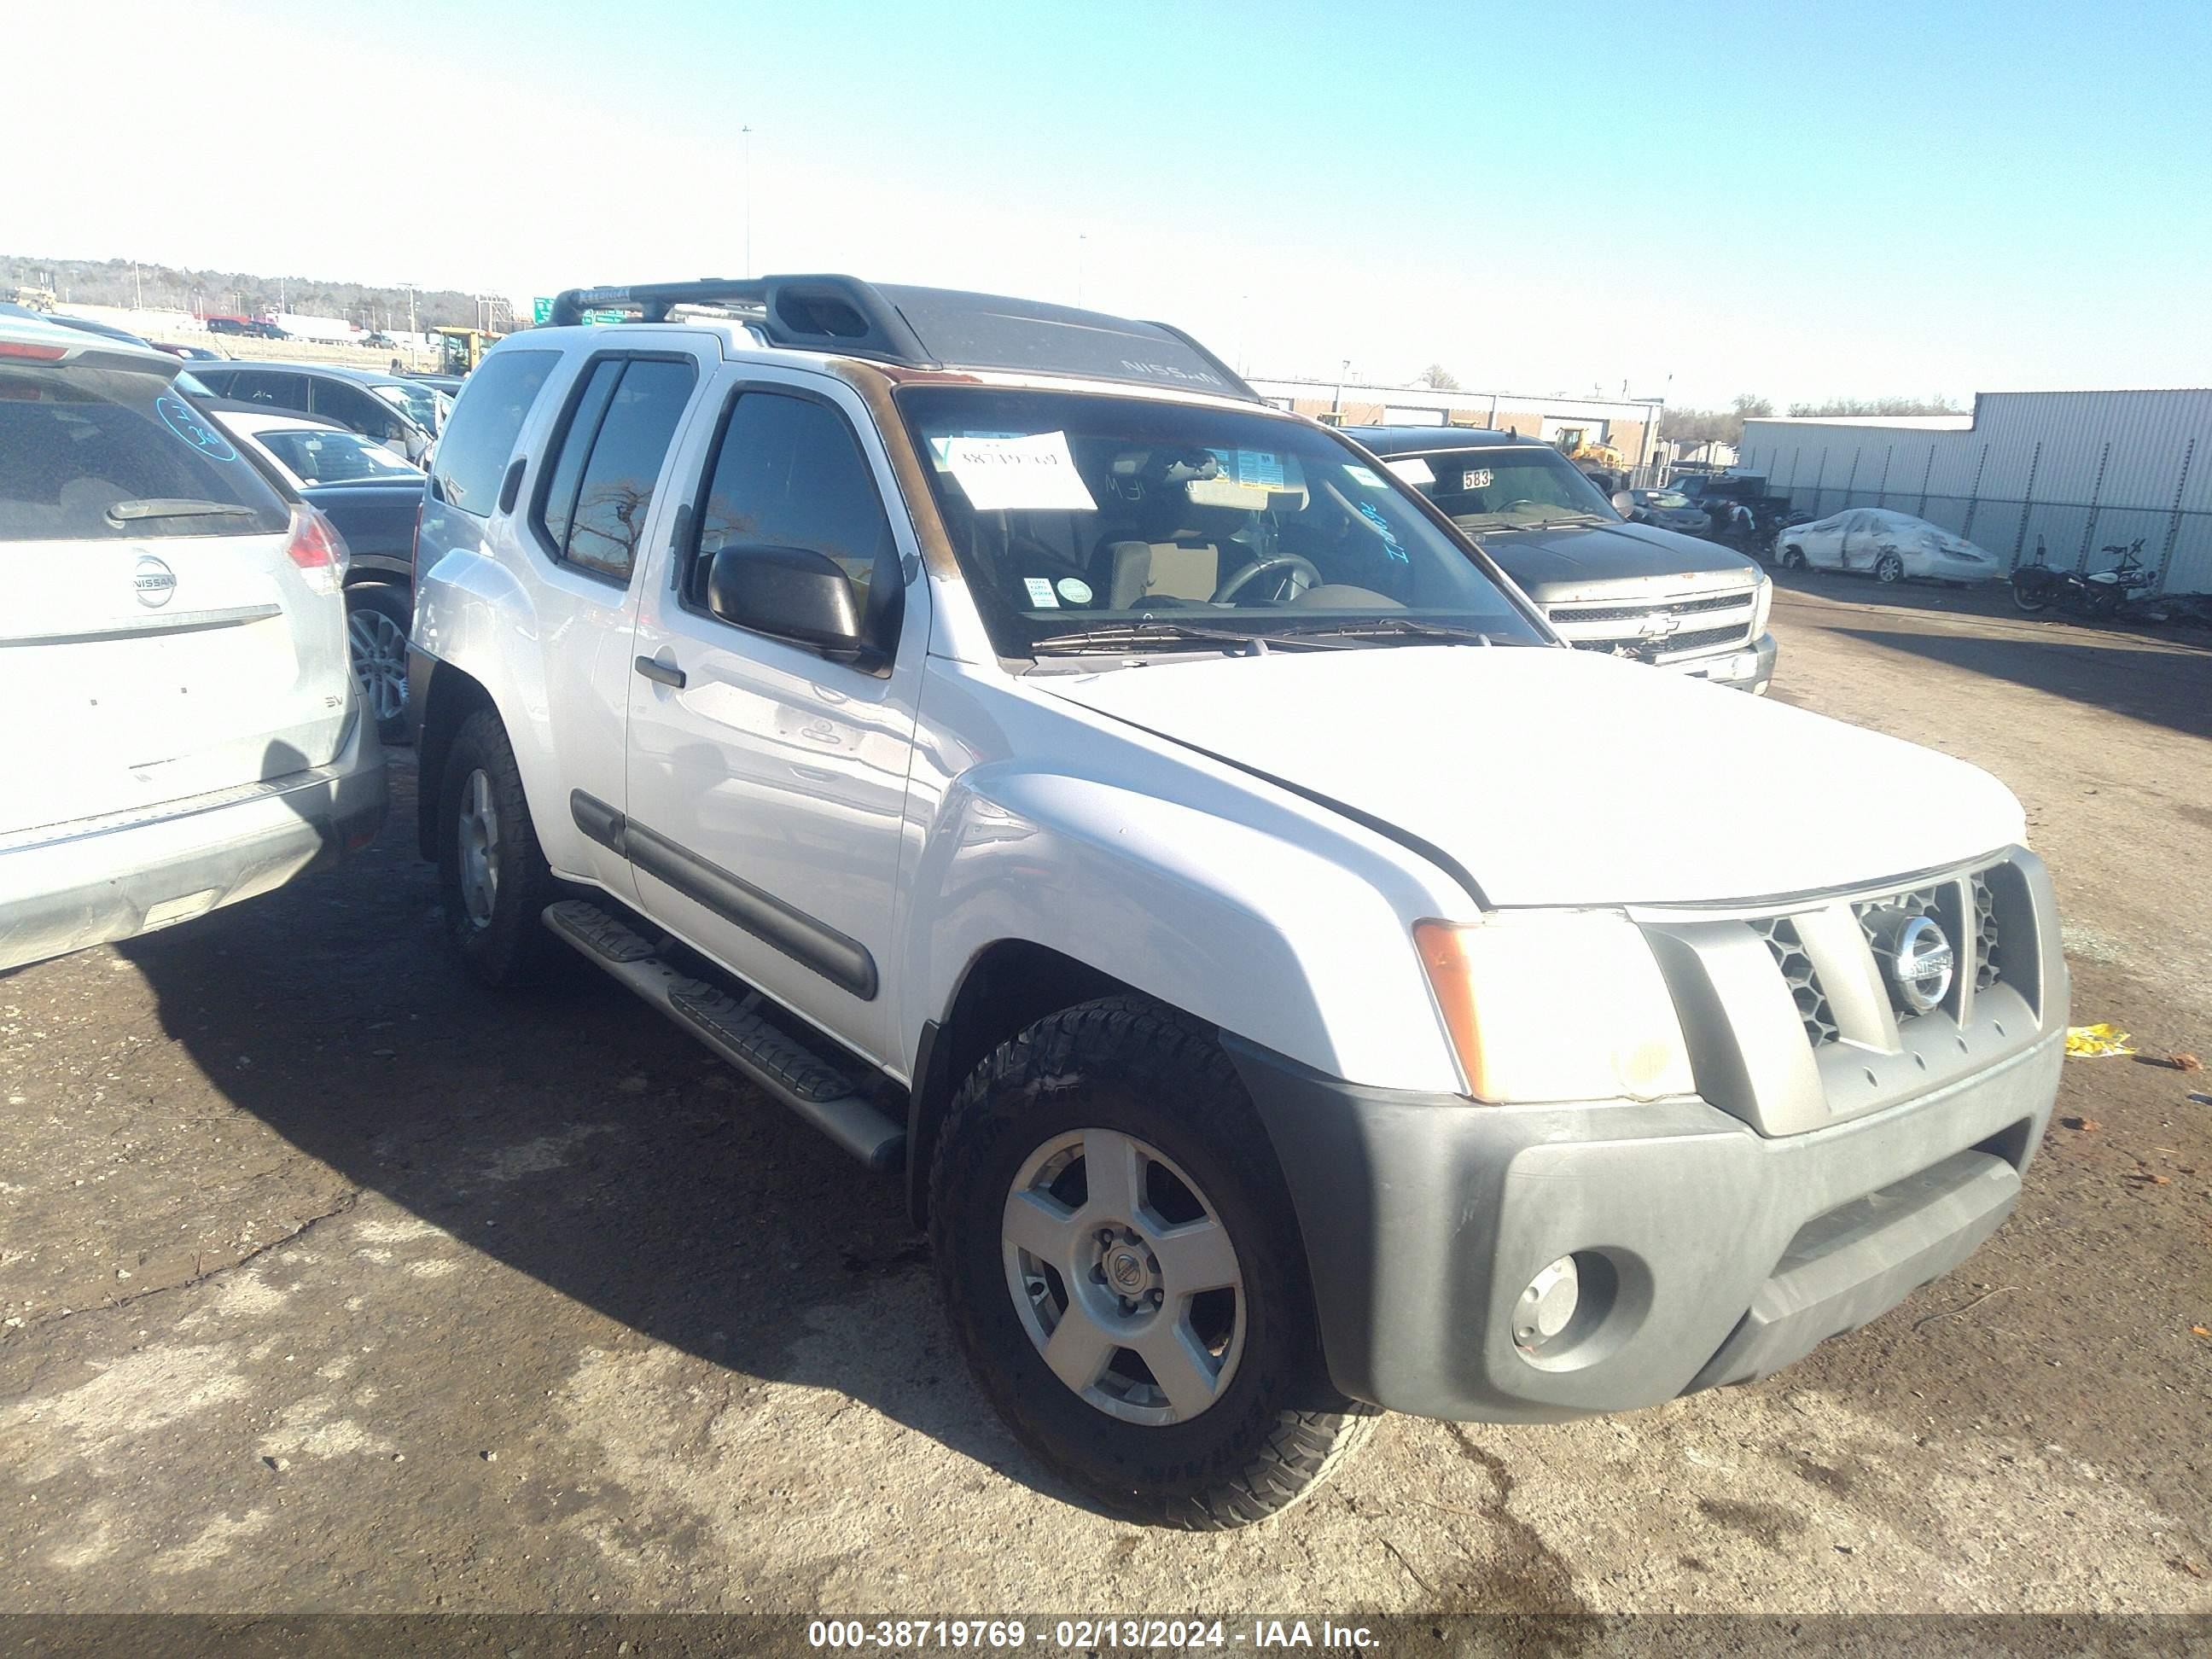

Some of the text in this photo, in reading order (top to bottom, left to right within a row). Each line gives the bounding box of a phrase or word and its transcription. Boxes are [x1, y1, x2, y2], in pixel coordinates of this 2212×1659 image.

[1120, 360, 1222, 386] NISSAN
[1465, 470, 1489, 487] 583
[132, 578, 174, 588] NISSAN
[324, 696, 343, 708] SV
